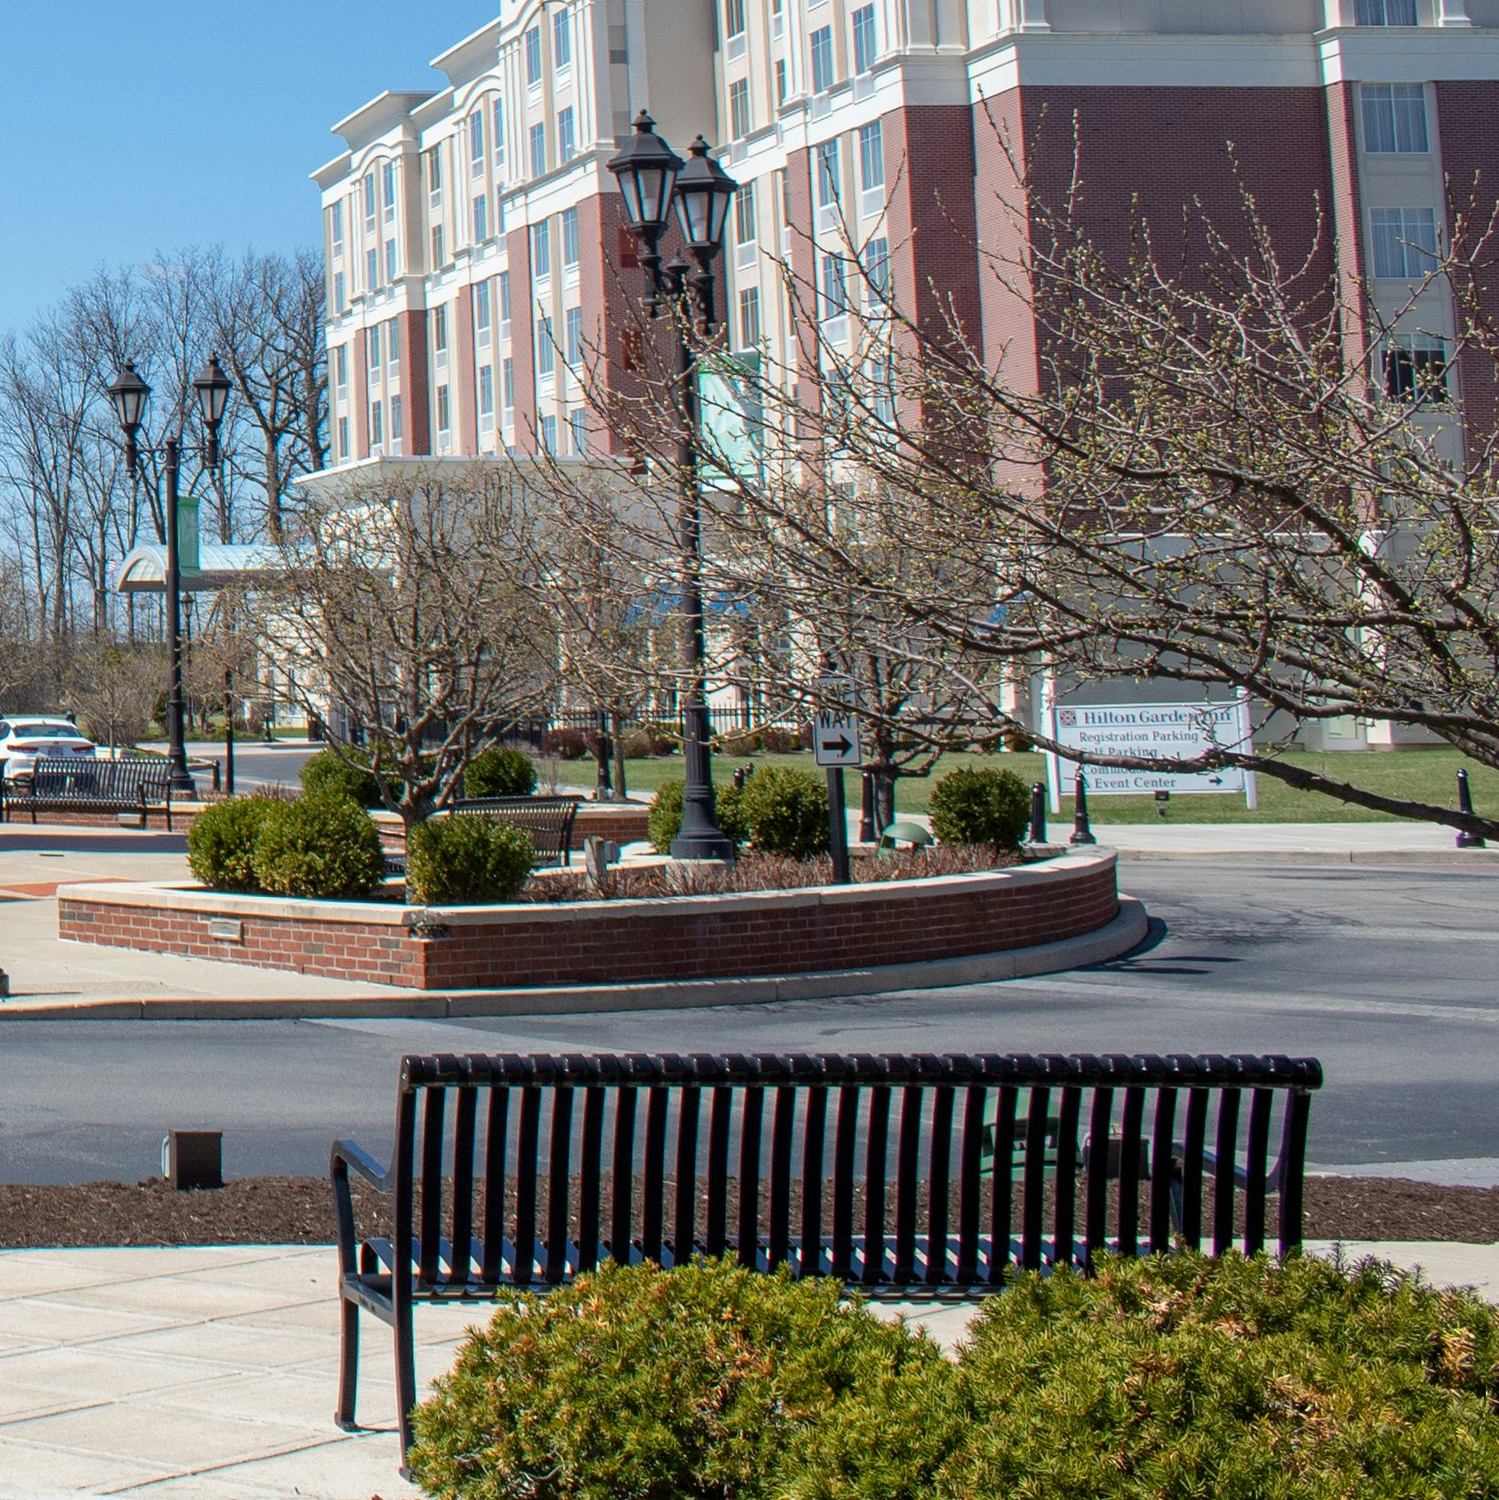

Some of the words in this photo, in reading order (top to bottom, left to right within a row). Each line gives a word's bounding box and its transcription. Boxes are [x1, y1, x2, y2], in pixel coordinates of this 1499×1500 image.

[1084, 711, 1136, 724] Hilton
[1079, 731, 1149, 744] Registration
[1152, 729, 1198, 743] Parking
[1095, 779, 1129, 789] Event
[1134, 777, 1176, 789] Center
